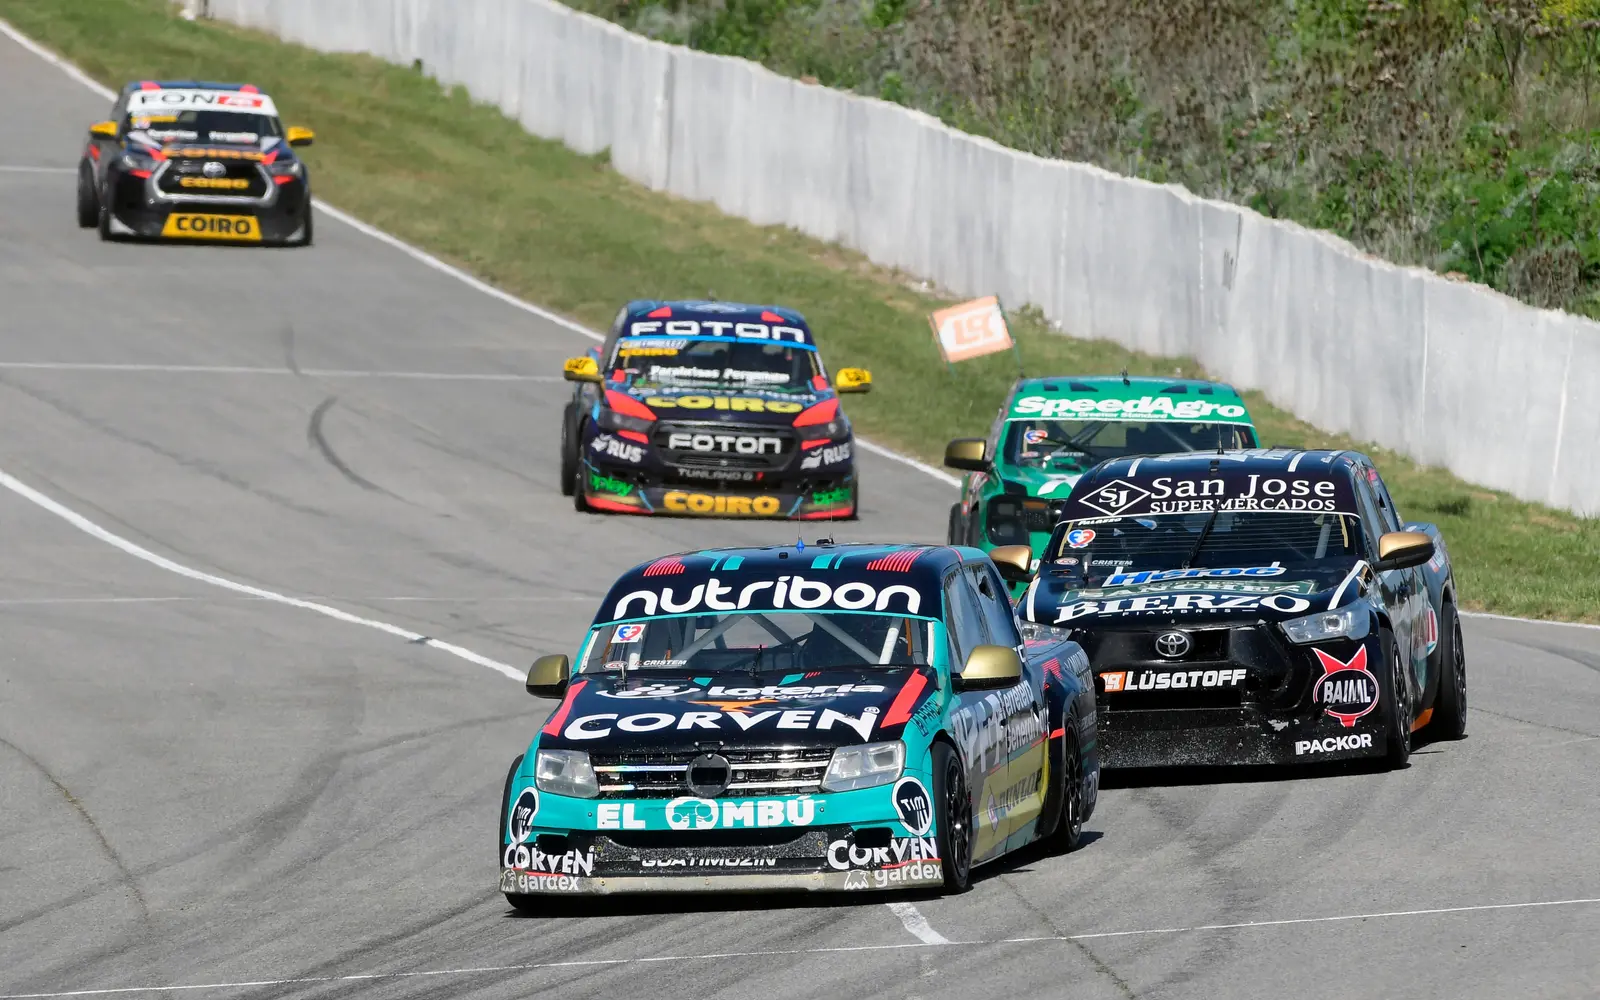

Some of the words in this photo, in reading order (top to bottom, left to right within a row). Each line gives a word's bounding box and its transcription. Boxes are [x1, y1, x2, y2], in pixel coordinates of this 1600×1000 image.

[176, 216, 251, 235] COIRO
[630, 320, 805, 344] FOTON
[645, 395, 803, 414] COIRO
[1014, 396, 1246, 419] SpeedAgro
[606, 438, 643, 464] RUS
[668, 433, 782, 455] FOTON
[1098, 487, 1131, 508] SJ
[1149, 477, 1225, 500] San
[1239, 474, 1336, 499] Jose
[663, 491, 780, 514] COIRO
[1149, 498, 1337, 514] SUPERMERCADOS
[1091, 559, 1134, 567] CRISTEM
[613, 575, 921, 621] nutribon
[1053, 593, 1311, 625] BIERZO
[1121, 607, 1232, 617] FIAMBRES
[643, 659, 688, 667] CRISTEM
[564, 708, 880, 743] CORVEN
[597, 803, 646, 829] EL
[875, 861, 942, 888] gardex
